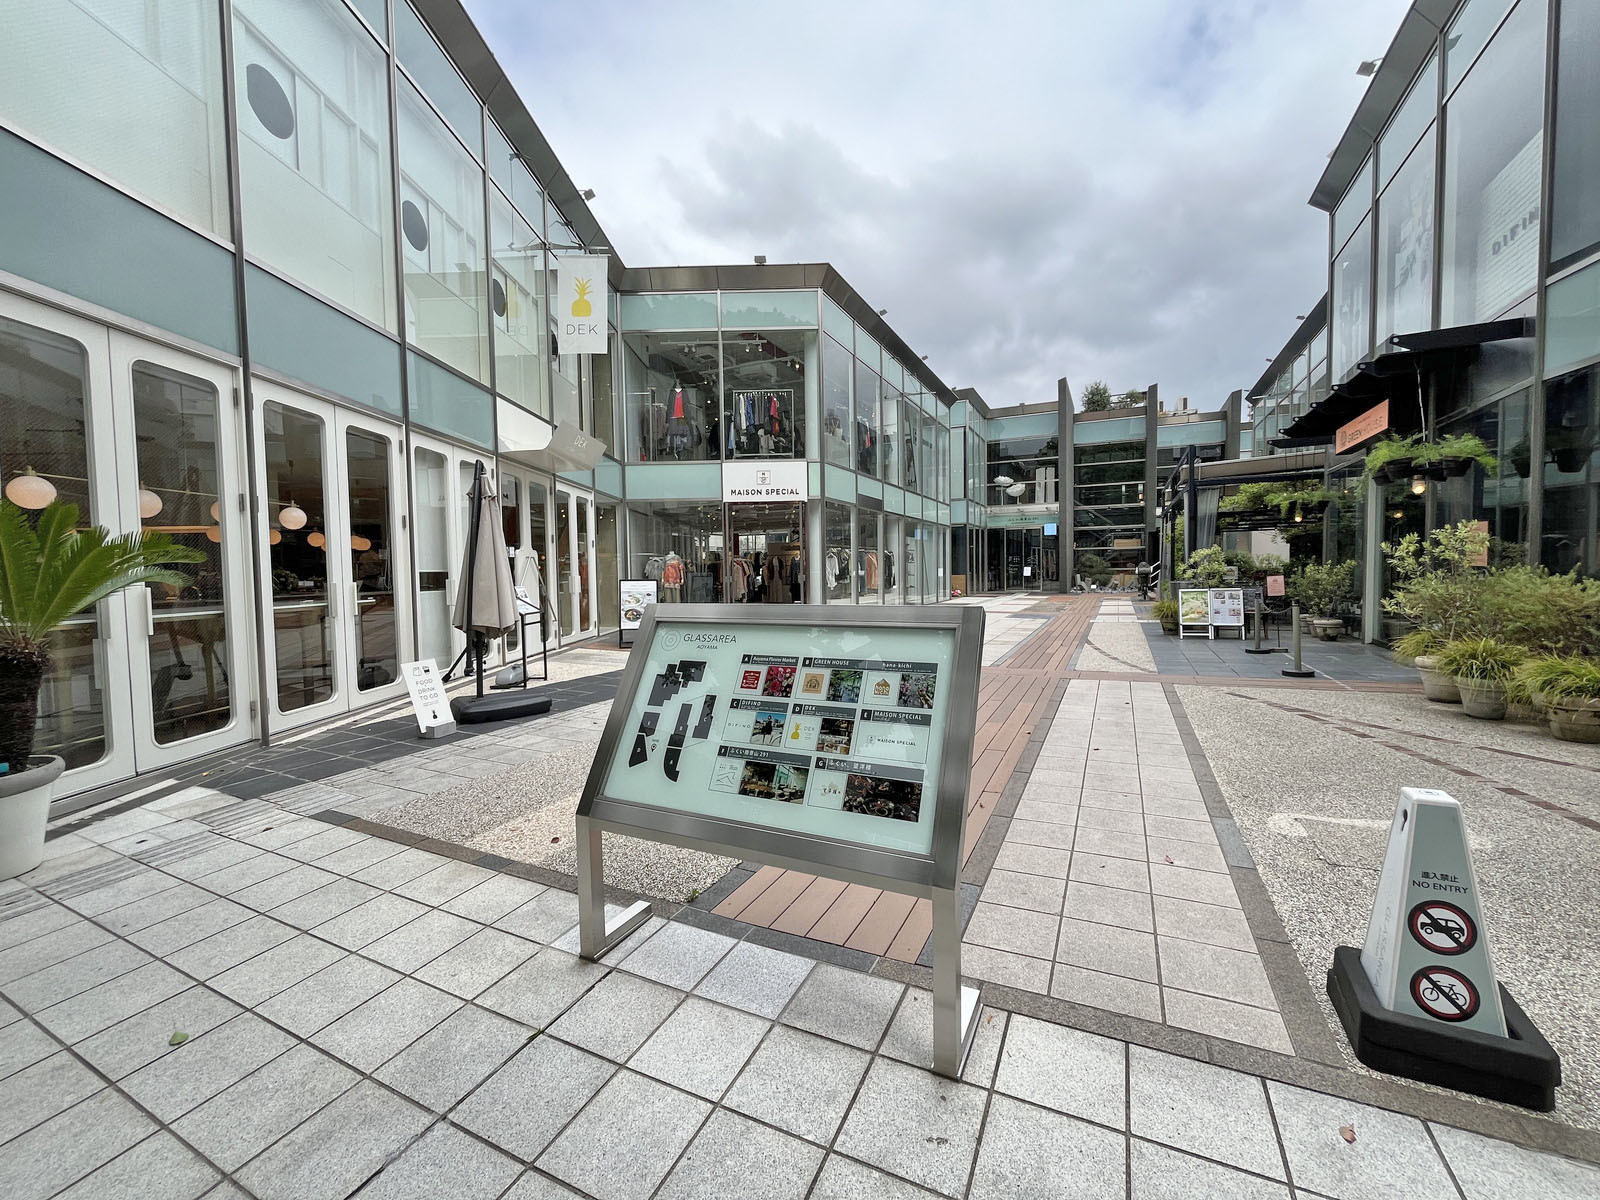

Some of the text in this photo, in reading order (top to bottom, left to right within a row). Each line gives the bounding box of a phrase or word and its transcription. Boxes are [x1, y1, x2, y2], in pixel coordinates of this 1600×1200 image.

[566, 323, 598, 335] DEK
[765, 488, 800, 496] SPECIAL
[683, 633, 737, 644] GLASSAREA
[874, 711, 897, 719] MAISON
[1412, 880, 1469, 894] NO ENTRY
